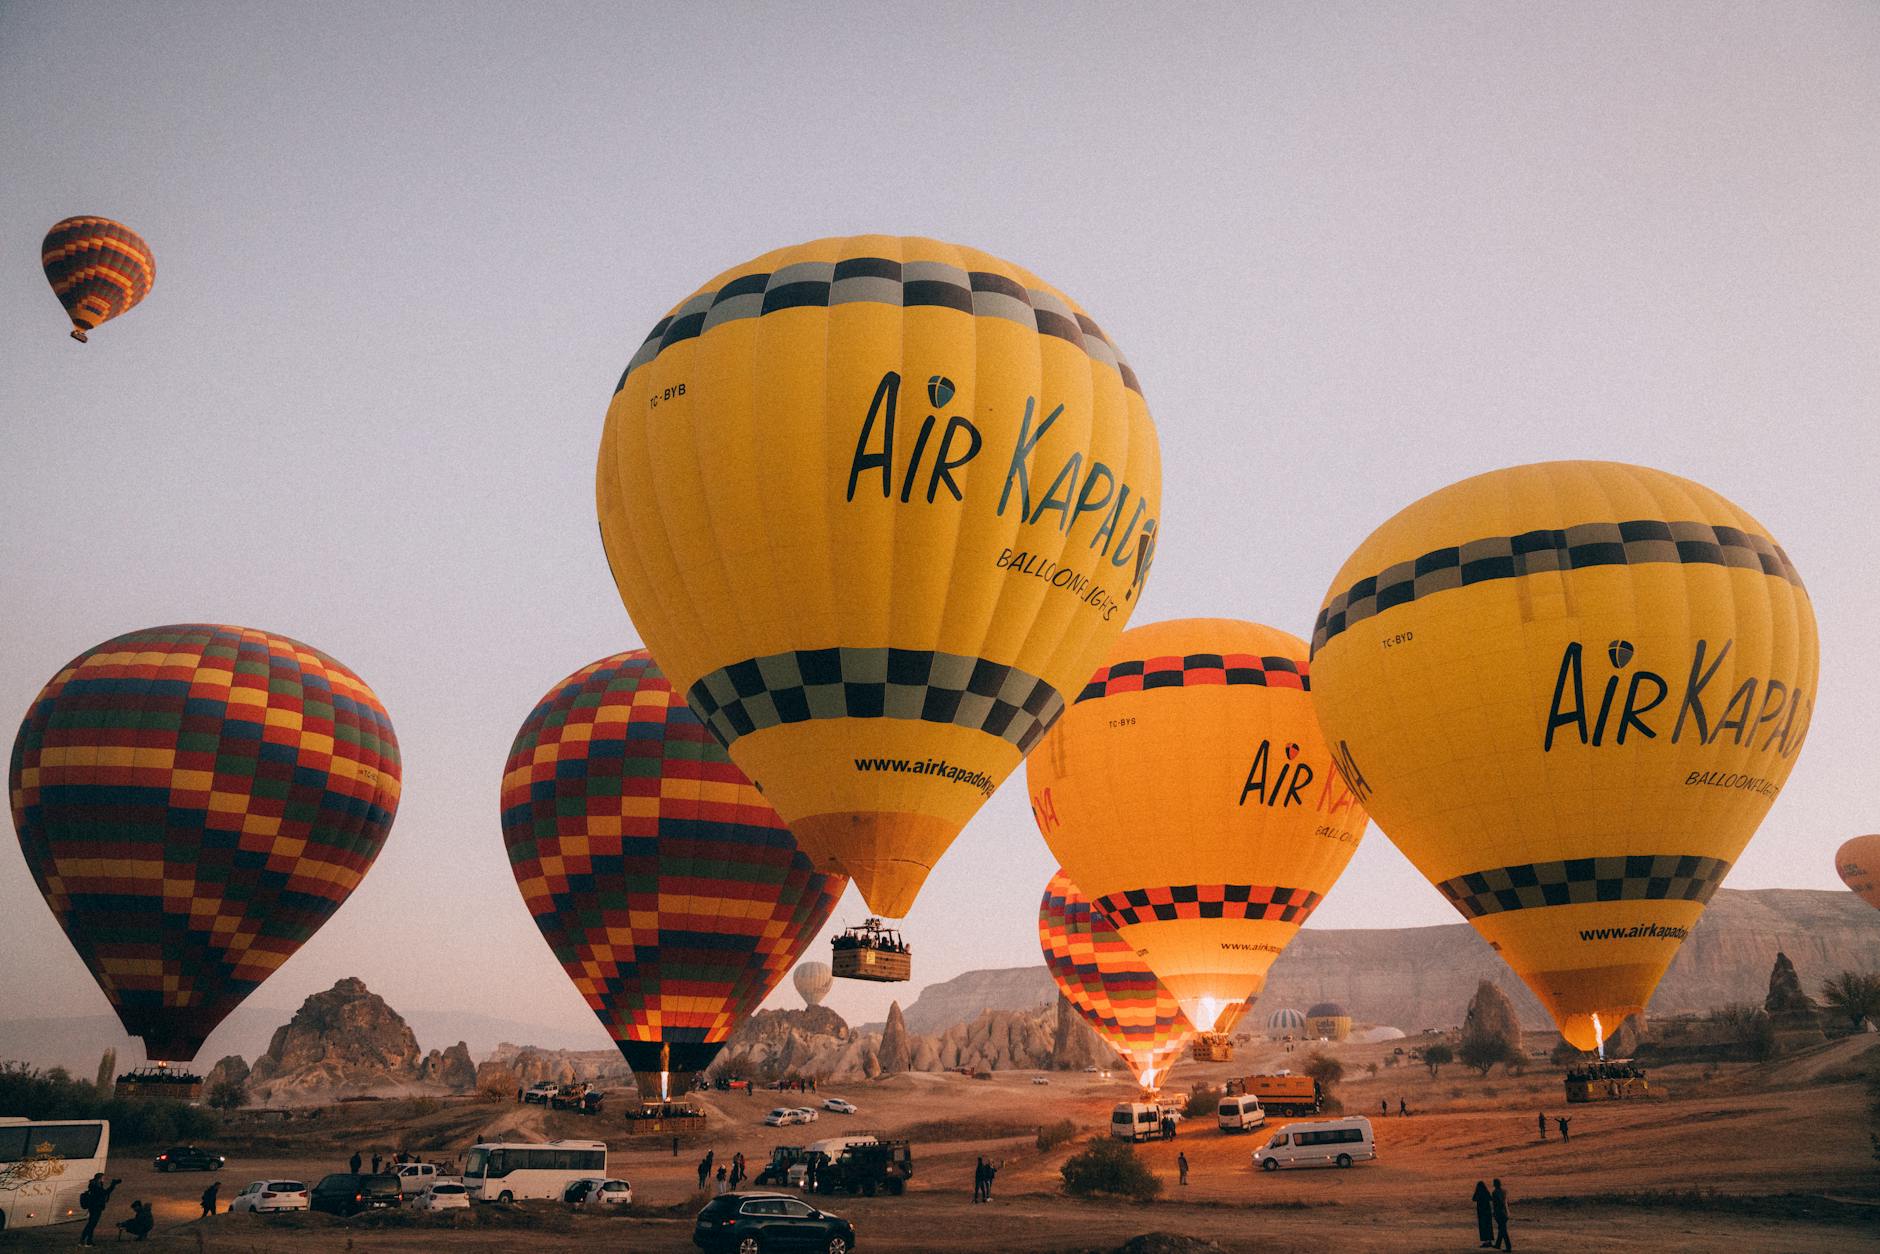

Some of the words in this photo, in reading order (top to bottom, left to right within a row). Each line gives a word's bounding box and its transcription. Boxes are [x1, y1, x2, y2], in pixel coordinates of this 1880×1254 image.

[649, 384, 686, 408] TC-BYB
[996, 548, 1118, 621] BALLOONFLIGHS
[1382, 632, 1413, 649] TC-BYD
[1109, 717, 1136, 728] TC-BYS
